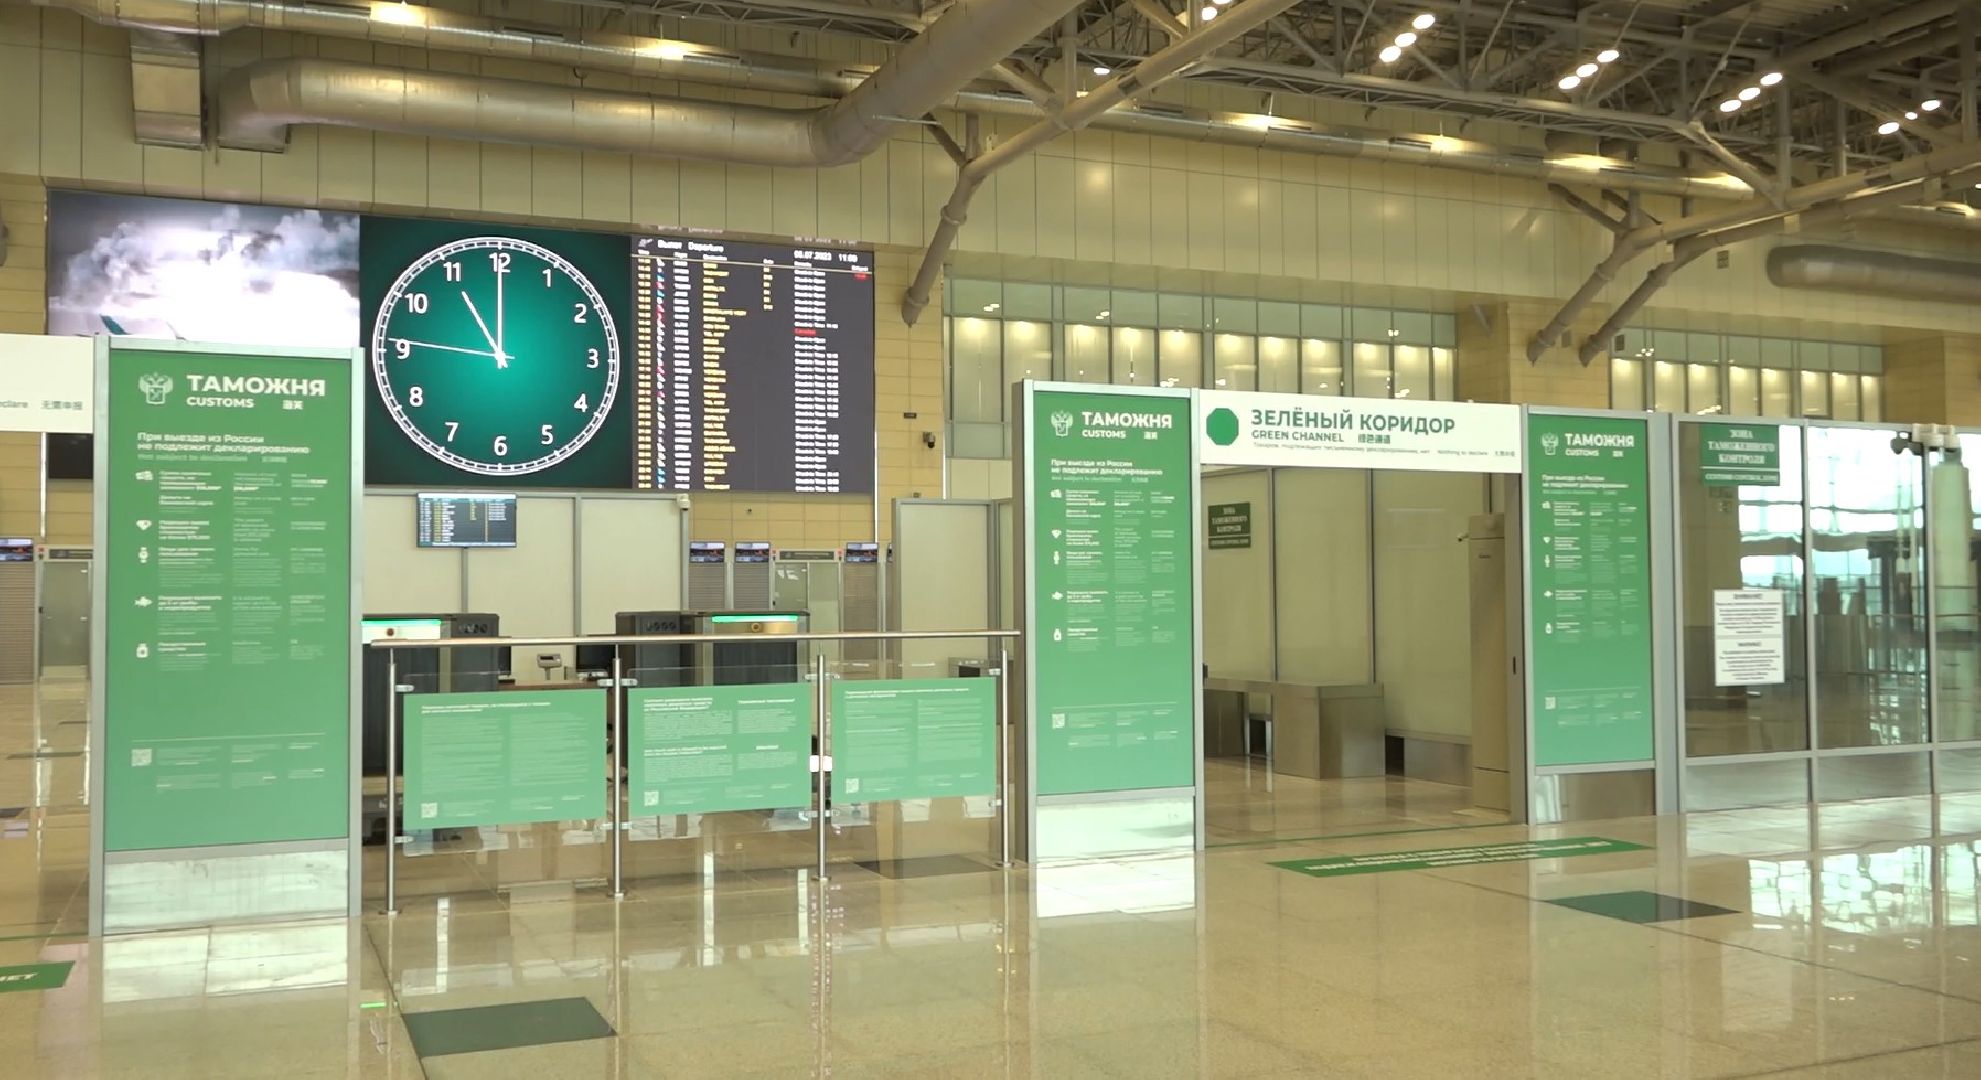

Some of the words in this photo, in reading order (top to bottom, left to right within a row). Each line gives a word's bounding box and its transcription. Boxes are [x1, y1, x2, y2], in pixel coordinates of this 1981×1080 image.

[443, 262, 461, 282] 11
[489, 252, 511, 273] 12
[543, 269, 552, 287] 1
[405, 293, 428, 314] 10
[574, 303, 587, 324] 2
[396, 339, 411, 359] 9
[587, 348, 598, 368] 3
[187, 375, 326, 397] ТАМОЖНЯ
[186, 397, 254, 408] CUSTOMS
[409, 387, 423, 407] 8
[574, 393, 588, 412] 4
[1082, 411, 1172, 429] ТАМОЖНЯ
[1251, 407, 1353, 430] ЗЕЛЁНЫЙ
[1360, 413, 1455, 435] КОРИДОР
[224, 434, 264, 443] России
[445, 422, 459, 442] 7
[541, 425, 553, 444] 5
[1082, 429, 1126, 440] CUSTOMS
[1251, 429, 1289, 440] GREEN
[1292, 431, 1344, 442] CHANNEL
[1565, 433, 1634, 447] ТАМОЖНЯ
[494, 436, 508, 456] 6
